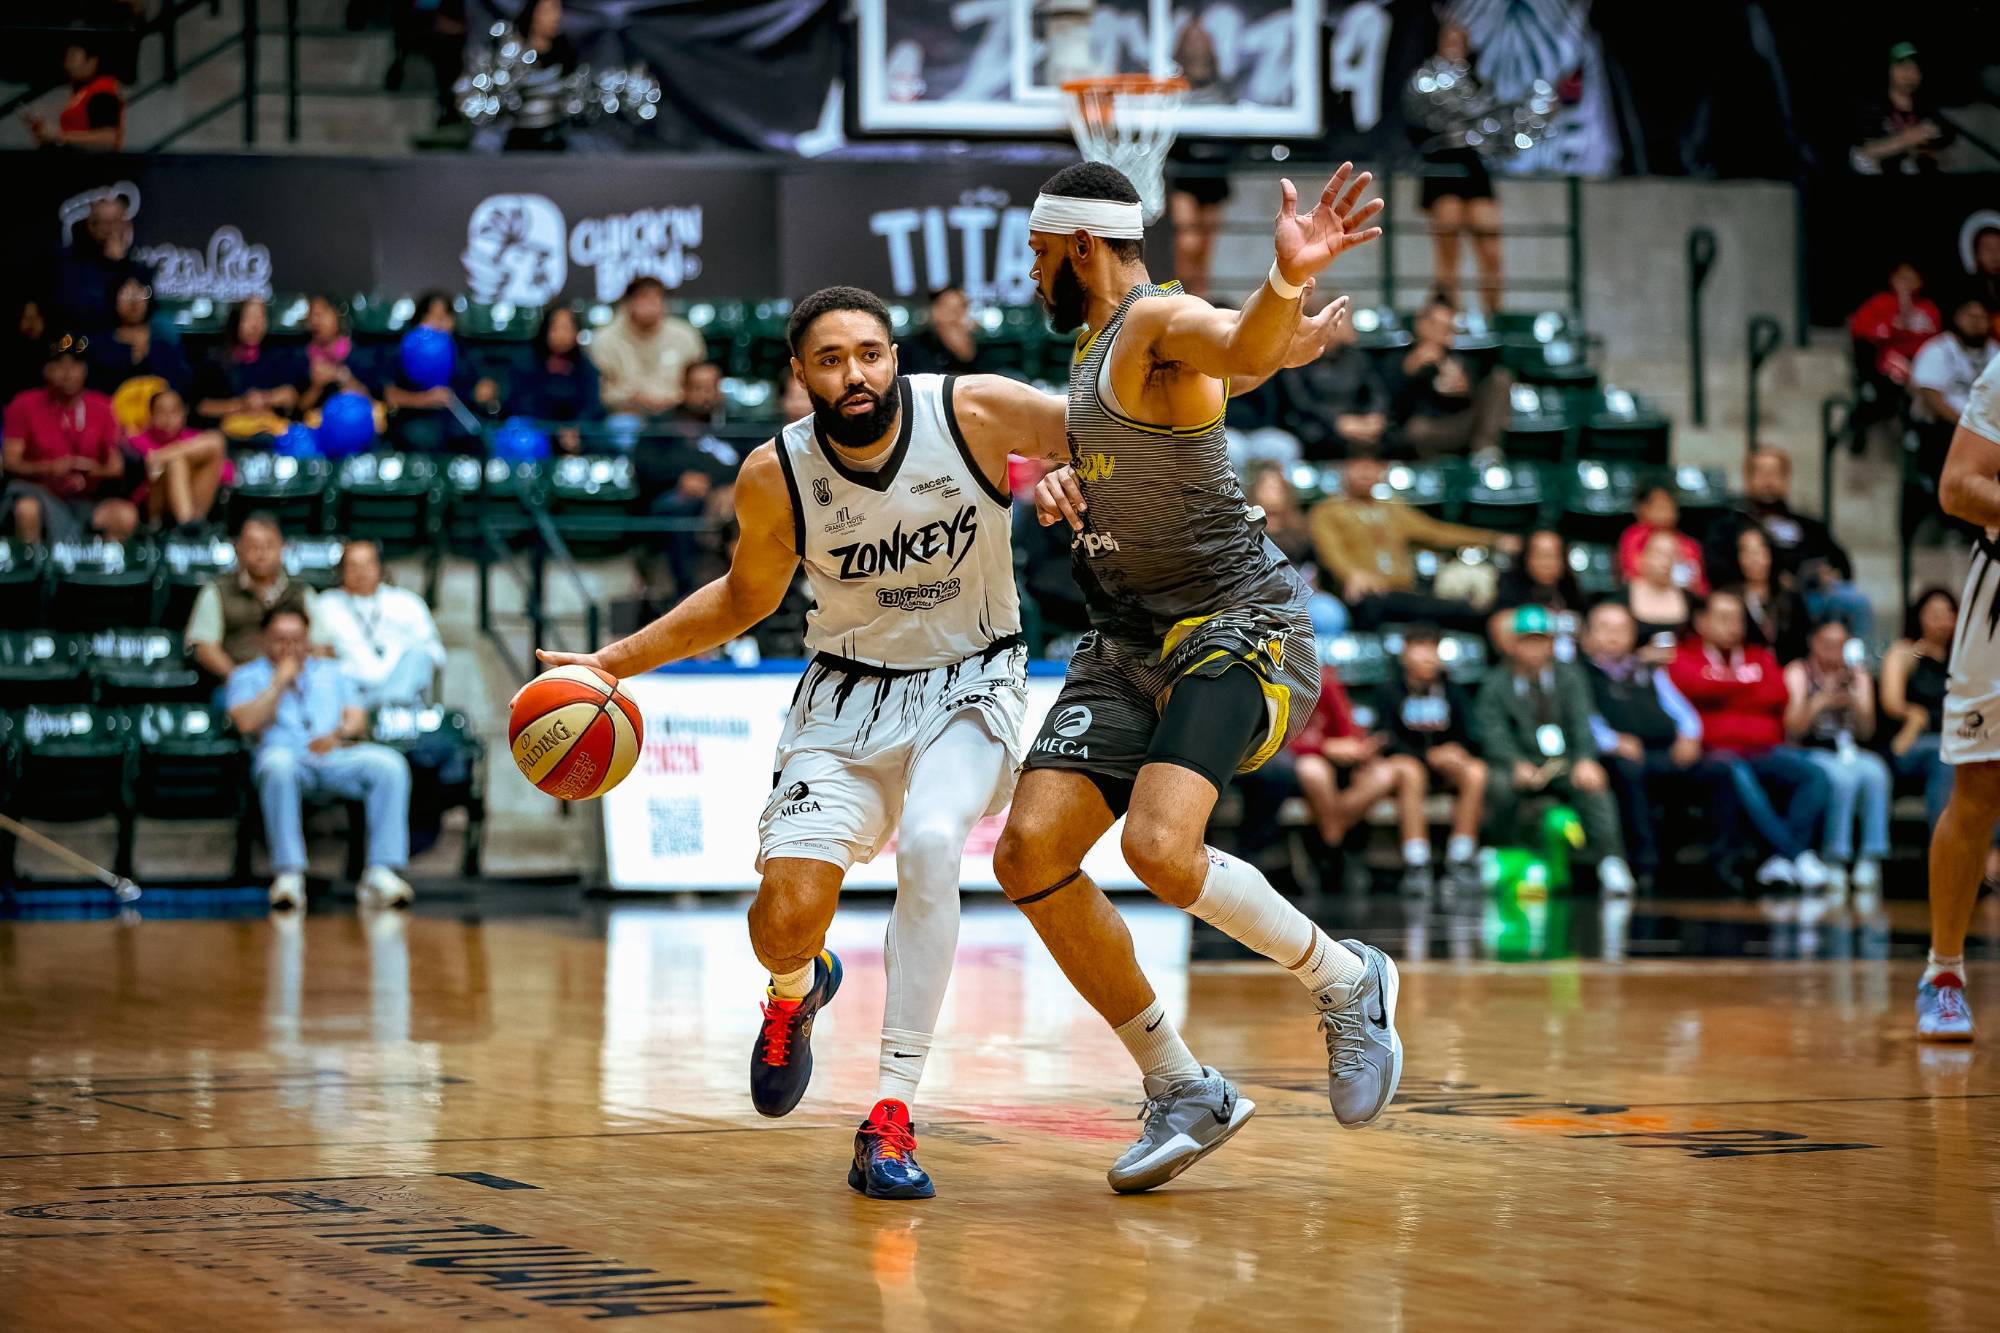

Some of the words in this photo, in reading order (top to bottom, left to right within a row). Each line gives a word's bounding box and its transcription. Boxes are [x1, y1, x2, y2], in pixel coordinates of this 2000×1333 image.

[872, 208, 1035, 305] TITA
[828, 504, 977, 580] ZONKEYS
[518, 719, 573, 780] PALDING
[1032, 738, 1088, 760] MEGA
[779, 801, 822, 819] MEGA
[313, 1223, 771, 1320] TIJUANA
